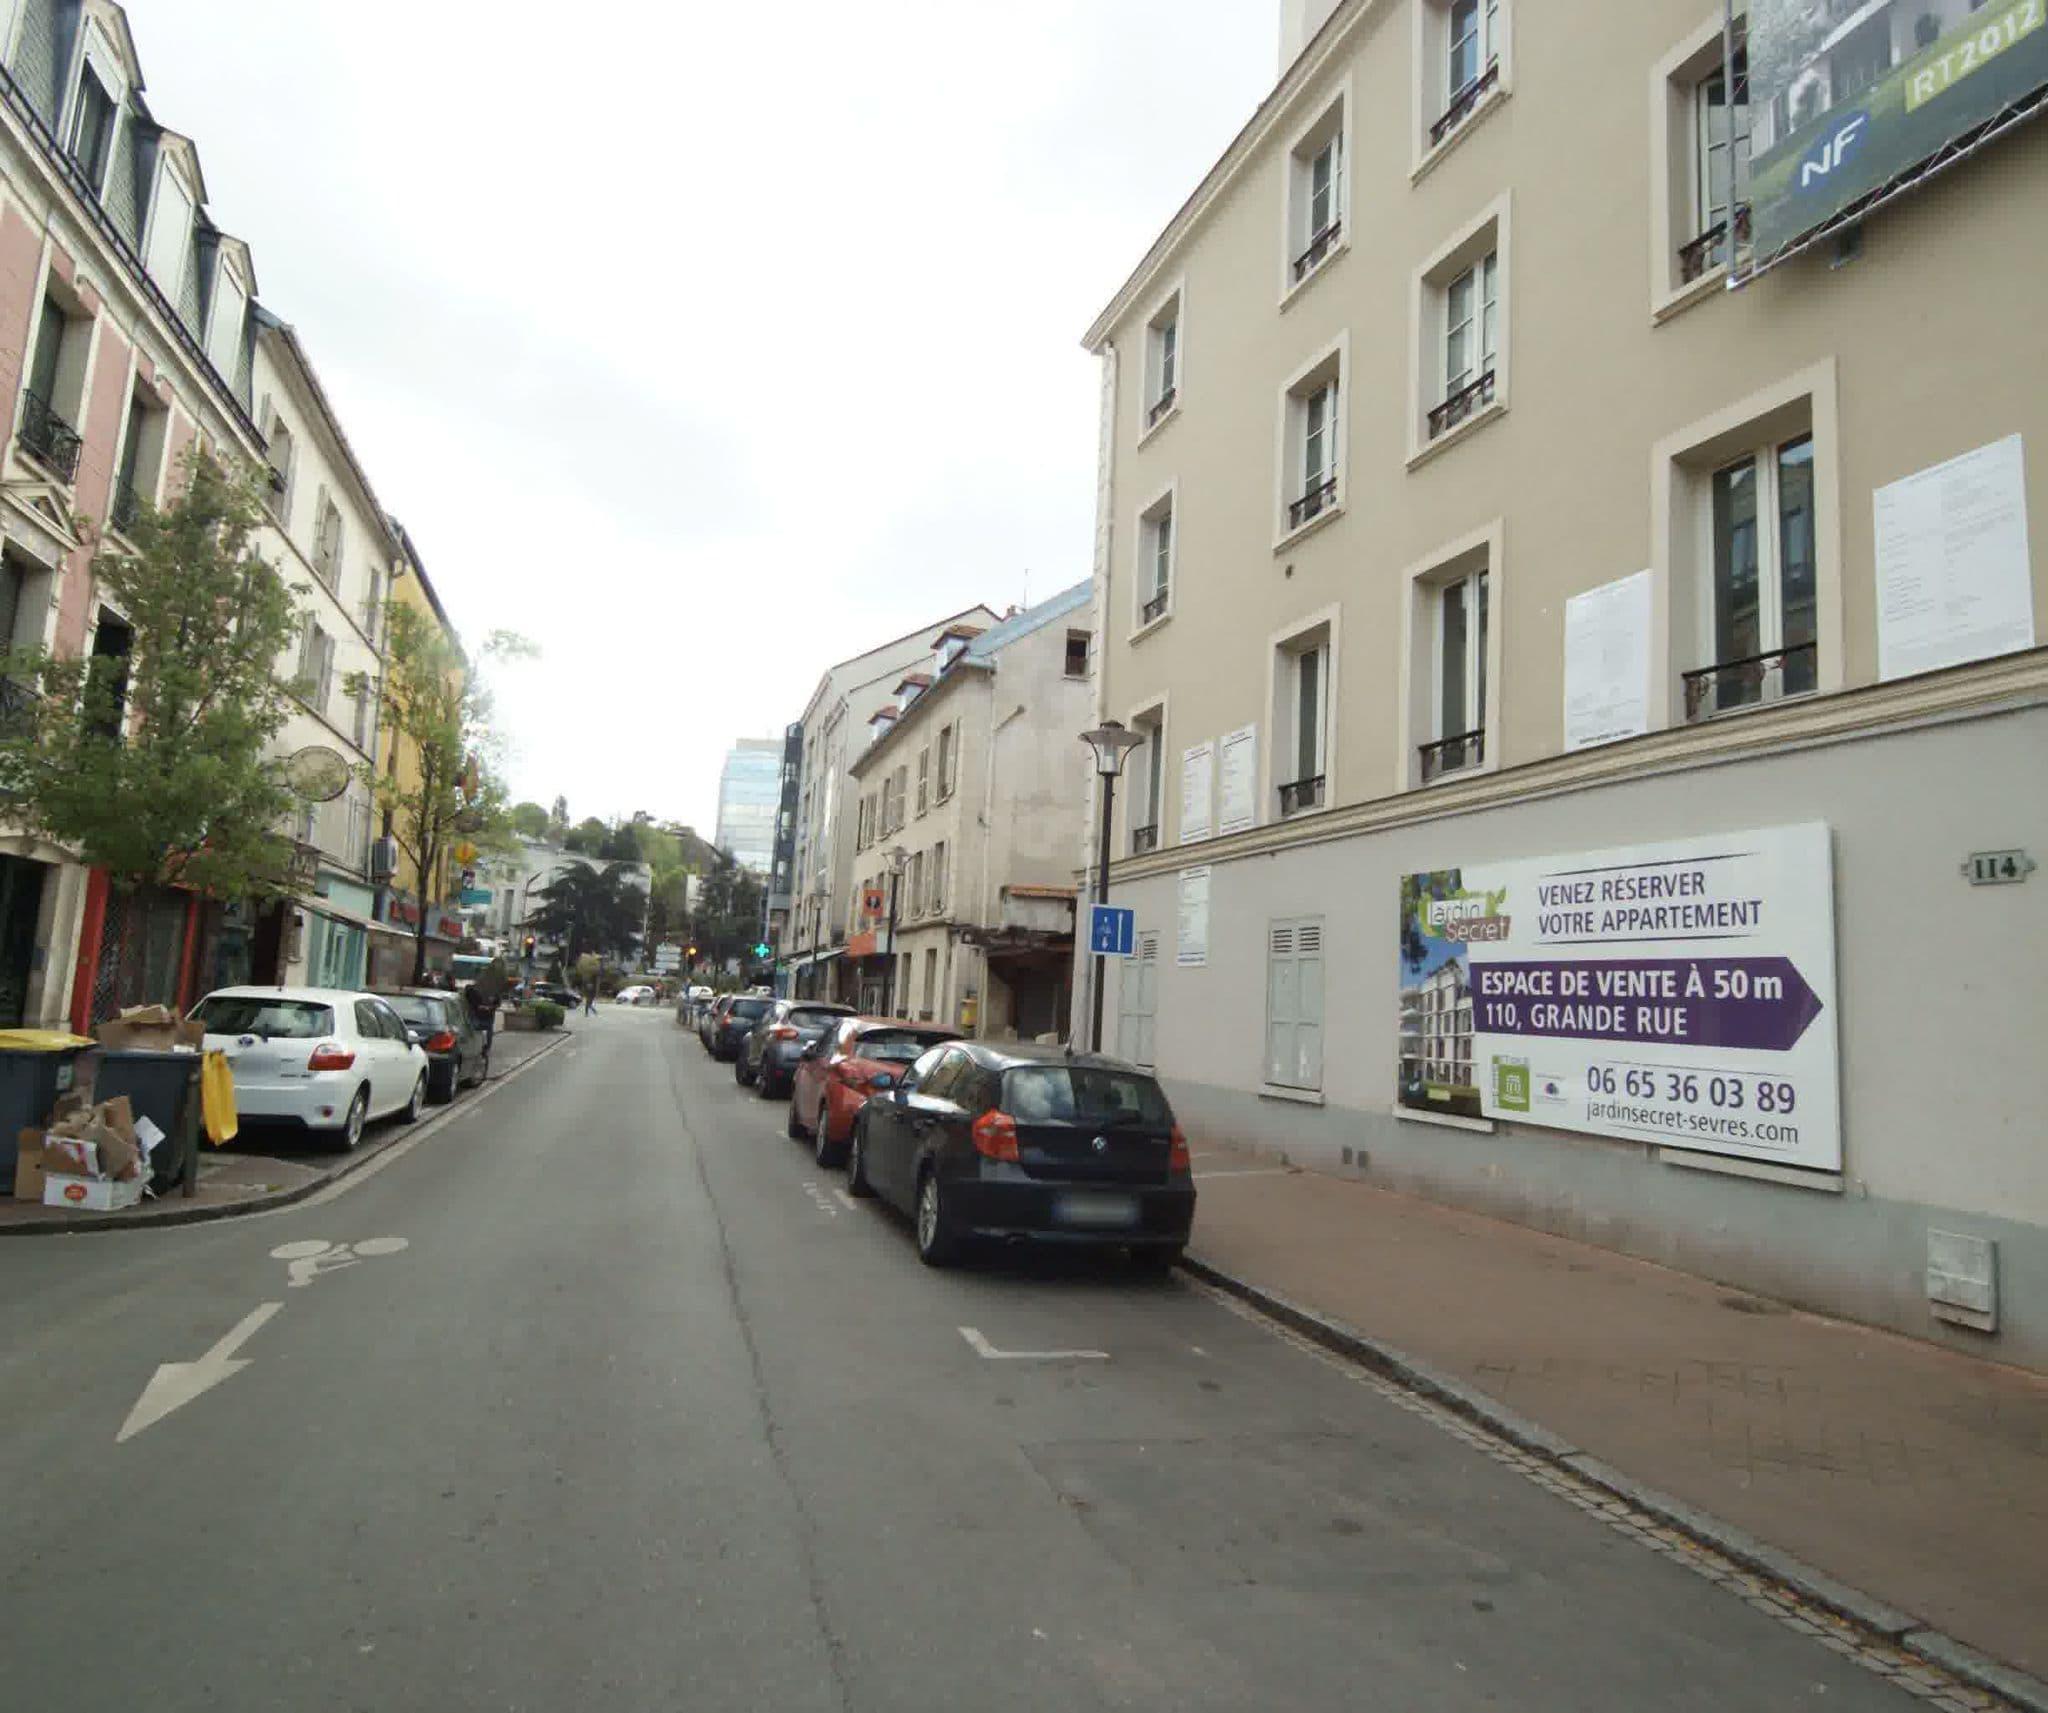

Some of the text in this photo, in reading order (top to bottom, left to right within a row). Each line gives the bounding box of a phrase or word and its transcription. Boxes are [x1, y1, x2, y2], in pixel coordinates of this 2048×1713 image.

[1801, 115, 1866, 187] NF
[1975, 856, 2017, 879] 114
[1539, 871, 1705, 906] VENEZ RÉSERVER
[1446, 919, 1509, 942] Secret
[1539, 900, 1763, 935] VOTRE APPARTEMENT
[1481, 963, 1784, 999] ESPACE DE VENTE À 50 m
[1486, 1003, 1688, 1035] 110, GRANDE RUE
[1587, 1066, 1796, 1114] 06 65 36 03 89
[1586, 1097, 1799, 1145] jardinsecret-sevres.com
